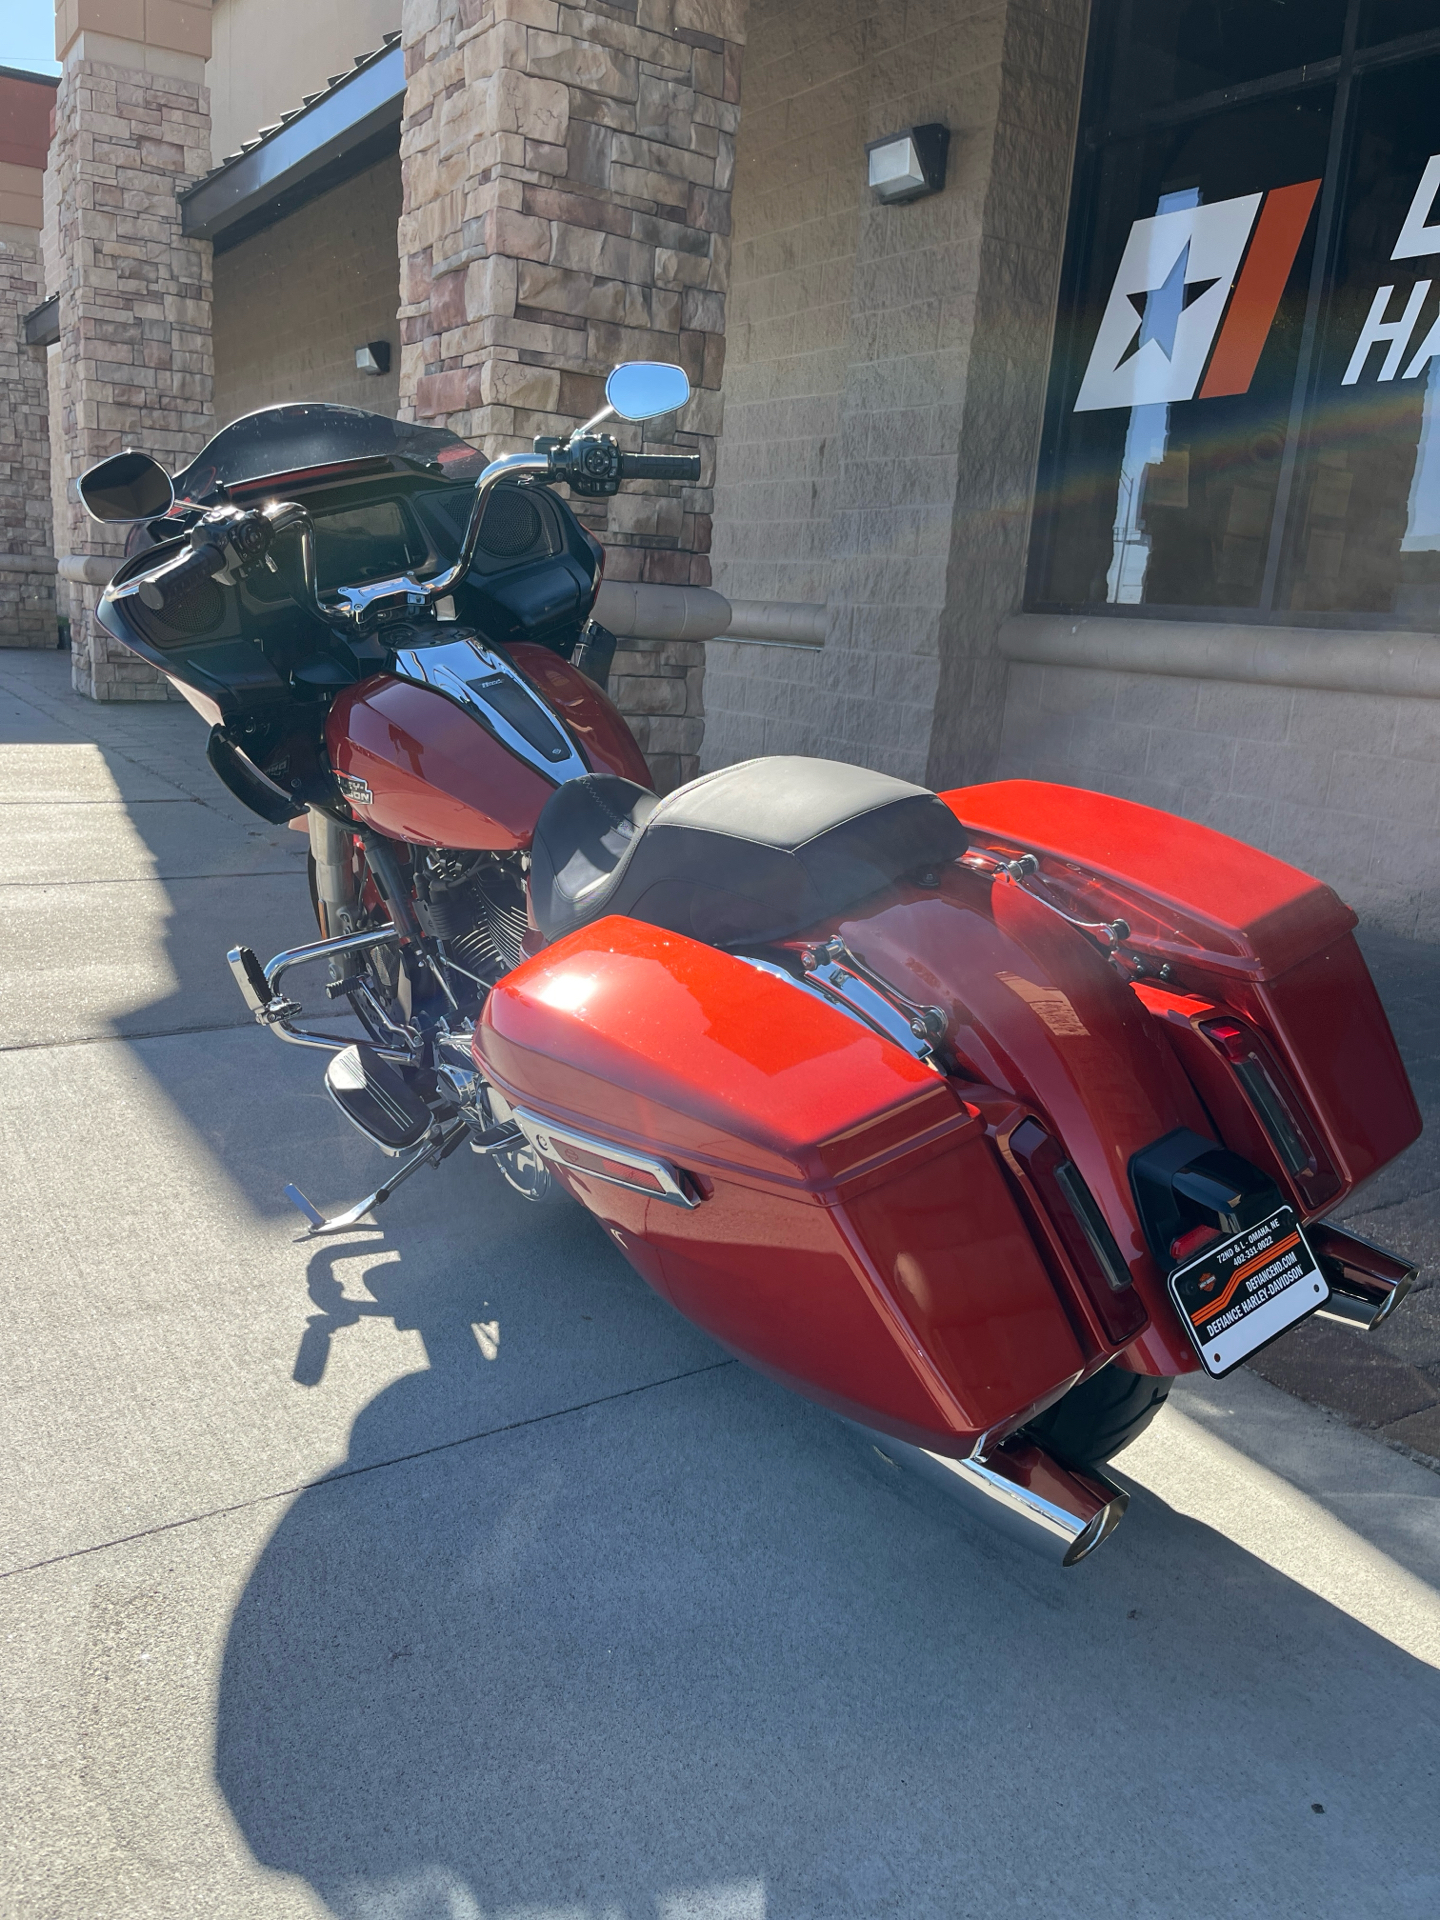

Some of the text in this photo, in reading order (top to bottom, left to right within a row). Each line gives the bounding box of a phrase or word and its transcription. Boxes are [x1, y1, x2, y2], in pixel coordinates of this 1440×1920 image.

[1216, 1248, 1234, 1264] 72ND
[1233, 1244, 1241, 1253] &
[1239, 1241, 1246, 1250] L
[1247, 1225, 1272, 1244] OMAHA,
[1269, 1218, 1280, 1230] NE
[1233, 1235, 1274, 1266] 402-331-0022
[1245, 1251, 1298, 1292] DEFIANCEHD.COM
[1206, 1264, 1304, 1337] DEFIANCE HARLEY-DAVIDSON
